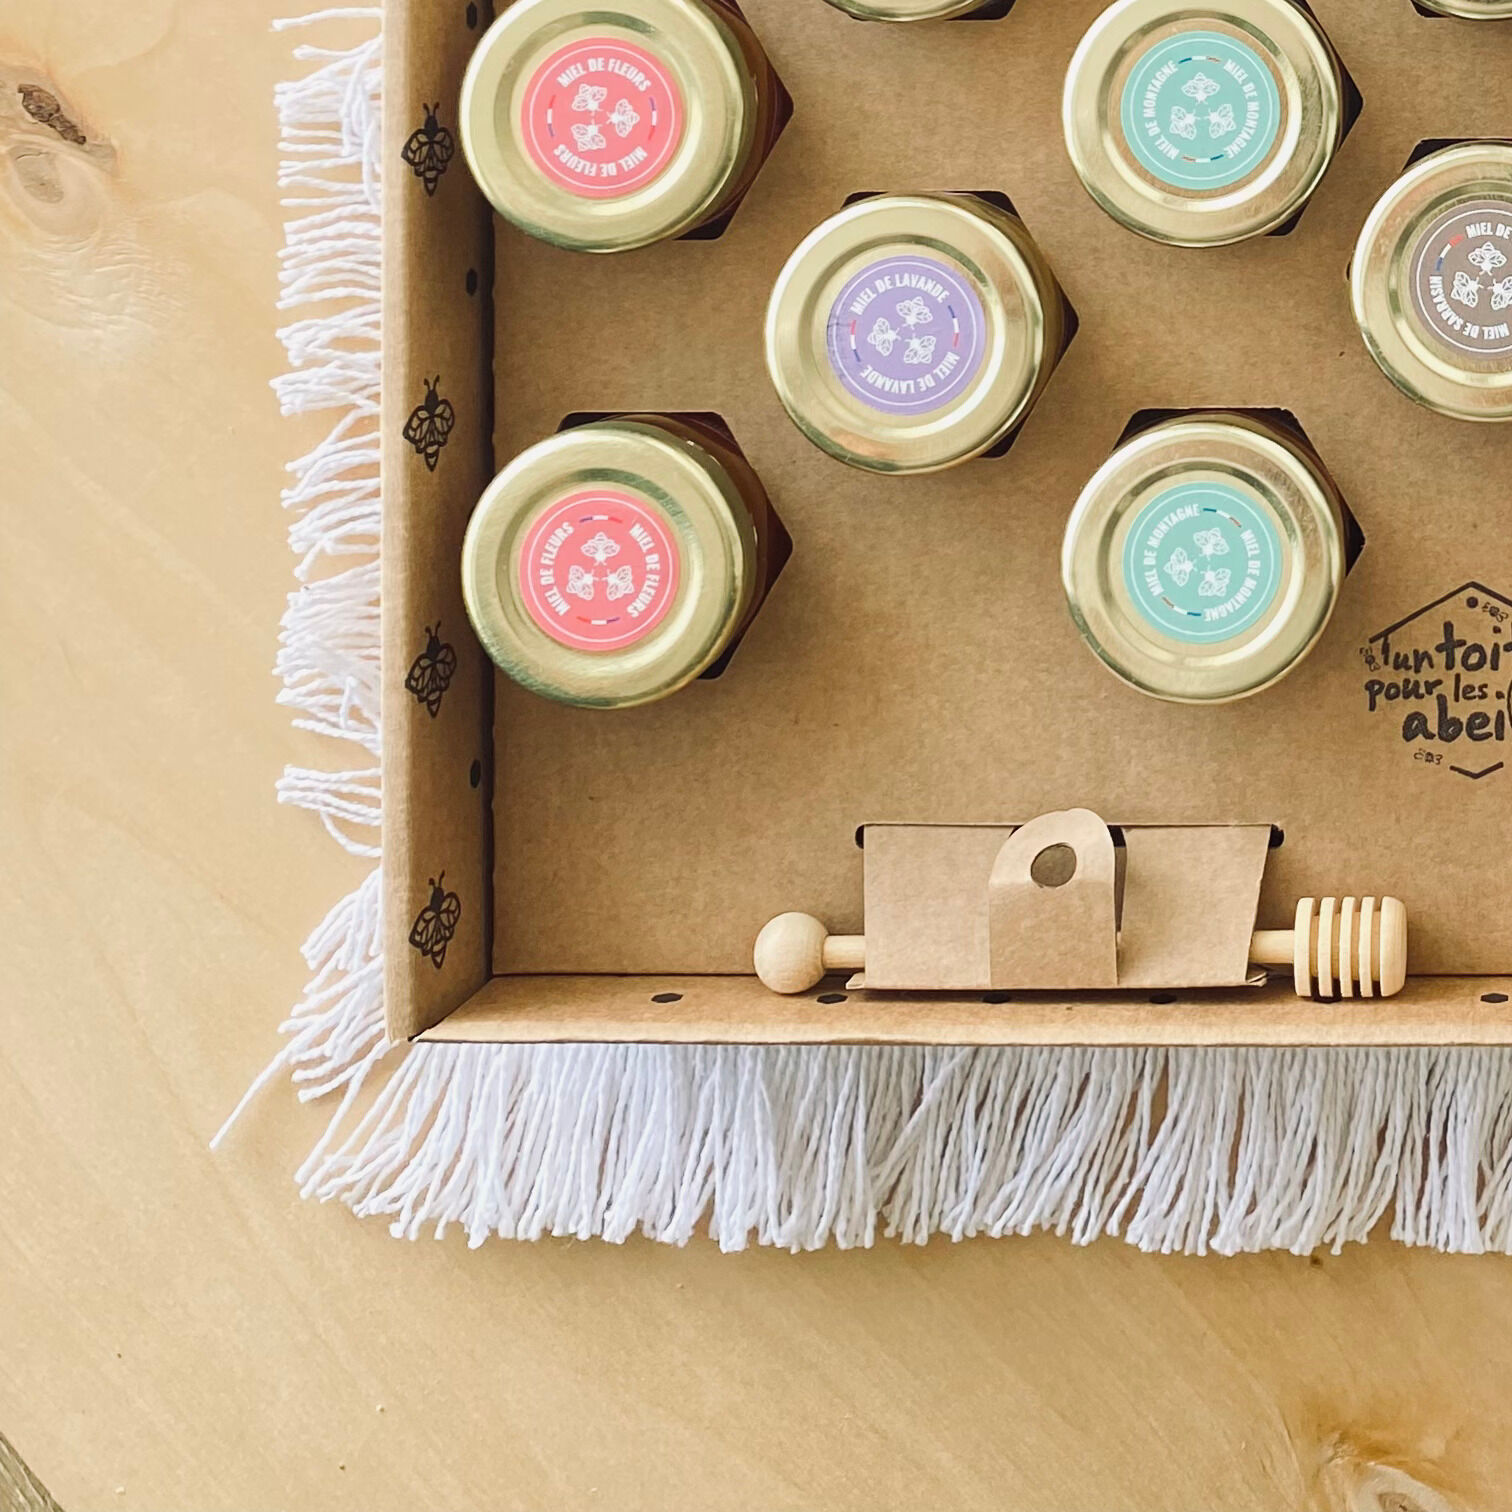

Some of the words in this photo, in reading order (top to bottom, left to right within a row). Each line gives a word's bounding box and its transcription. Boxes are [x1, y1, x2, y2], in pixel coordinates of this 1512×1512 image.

[557, 63, 586, 87] MIEL
[588, 58, 604, 72] DE
[608, 59, 651, 91] FLEURS
[1224, 59, 1248, 84] MIEL
[1144, 61, 1178, 117] MONTAGNE
[1243, 83, 1257, 99] DE
[1145, 120, 1160, 136] DE
[1224, 102, 1259, 158] MONTAGNE
[554, 144, 597, 176] FLEURS
[618, 147, 647, 171] MIEL
[1155, 135, 1179, 160] MIEL
[600, 163, 616, 176] DE
[1466, 223, 1493, 238] MIEL
[1496, 224, 1512, 239] DE
[850, 288, 877, 315] MIEL
[875, 276, 893, 293] DE
[895, 273, 949, 303] LAVANDE
[1430, 276, 1463, 330] SARRASIN
[1463, 323, 1479, 338] DE
[1482, 323, 1509, 339] MIEL
[933, 352, 960, 379] MIEL
[860, 365, 914, 394] LAVANDE
[917, 374, 935, 391] DE
[629, 524, 654, 552] MIEL
[1147, 504, 1199, 547] MONTAGNE
[541, 522, 574, 565] FLEURS
[1240, 530, 1260, 557] MIEL
[645, 554, 660, 570] DE
[1144, 550, 1156, 565] DE
[1248, 560, 1260, 576] DE
[540, 569, 554, 585] DE
[1144, 568, 1164, 596] MIEL
[545, 586, 570, 615] MIEL
[627, 574, 659, 617] FLEURS
[1204, 577, 1256, 621] MONTAGNE
[1364, 678, 1443, 712] pour
[1454, 673, 1488, 702] les
